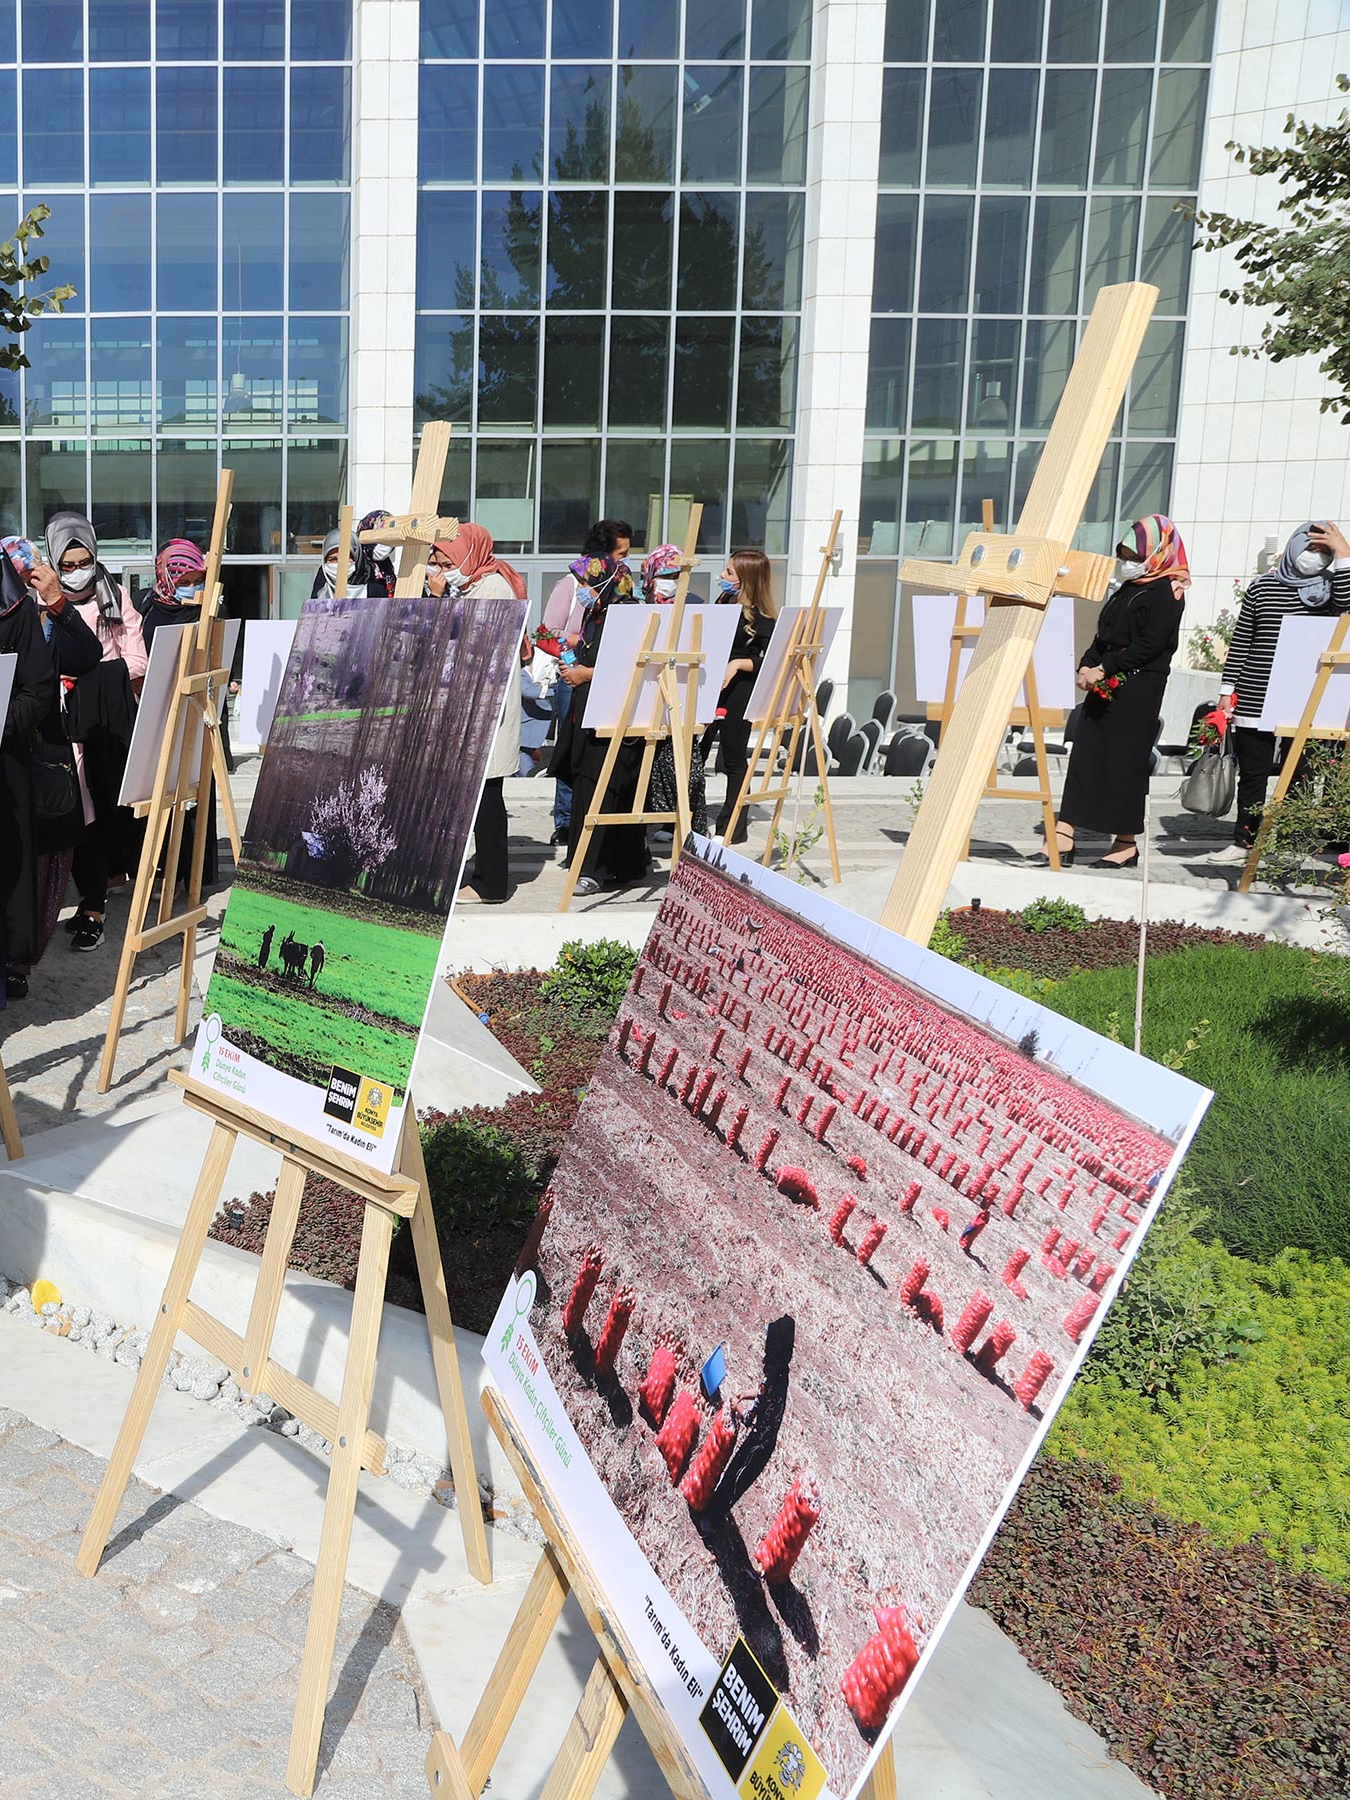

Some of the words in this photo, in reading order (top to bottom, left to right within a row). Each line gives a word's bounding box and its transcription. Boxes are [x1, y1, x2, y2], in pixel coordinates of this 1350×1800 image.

[328, 1092, 354, 1111] ŞEHRİM
[330, 1078, 357, 1098] BENİM
[516, 1334, 526, 1350] 15
[521, 1347, 539, 1377] EKİM
[508, 1351, 525, 1381] Dünya
[521, 1377, 539, 1405] Kadın
[535, 1402, 559, 1442] Çiftçiler
[554, 1436, 573, 1470] Günü
[668, 1644, 690, 1683] Kadın
[722, 1662, 766, 1736] BENİM
[711, 1687, 753, 1758] ŞEHRİM
